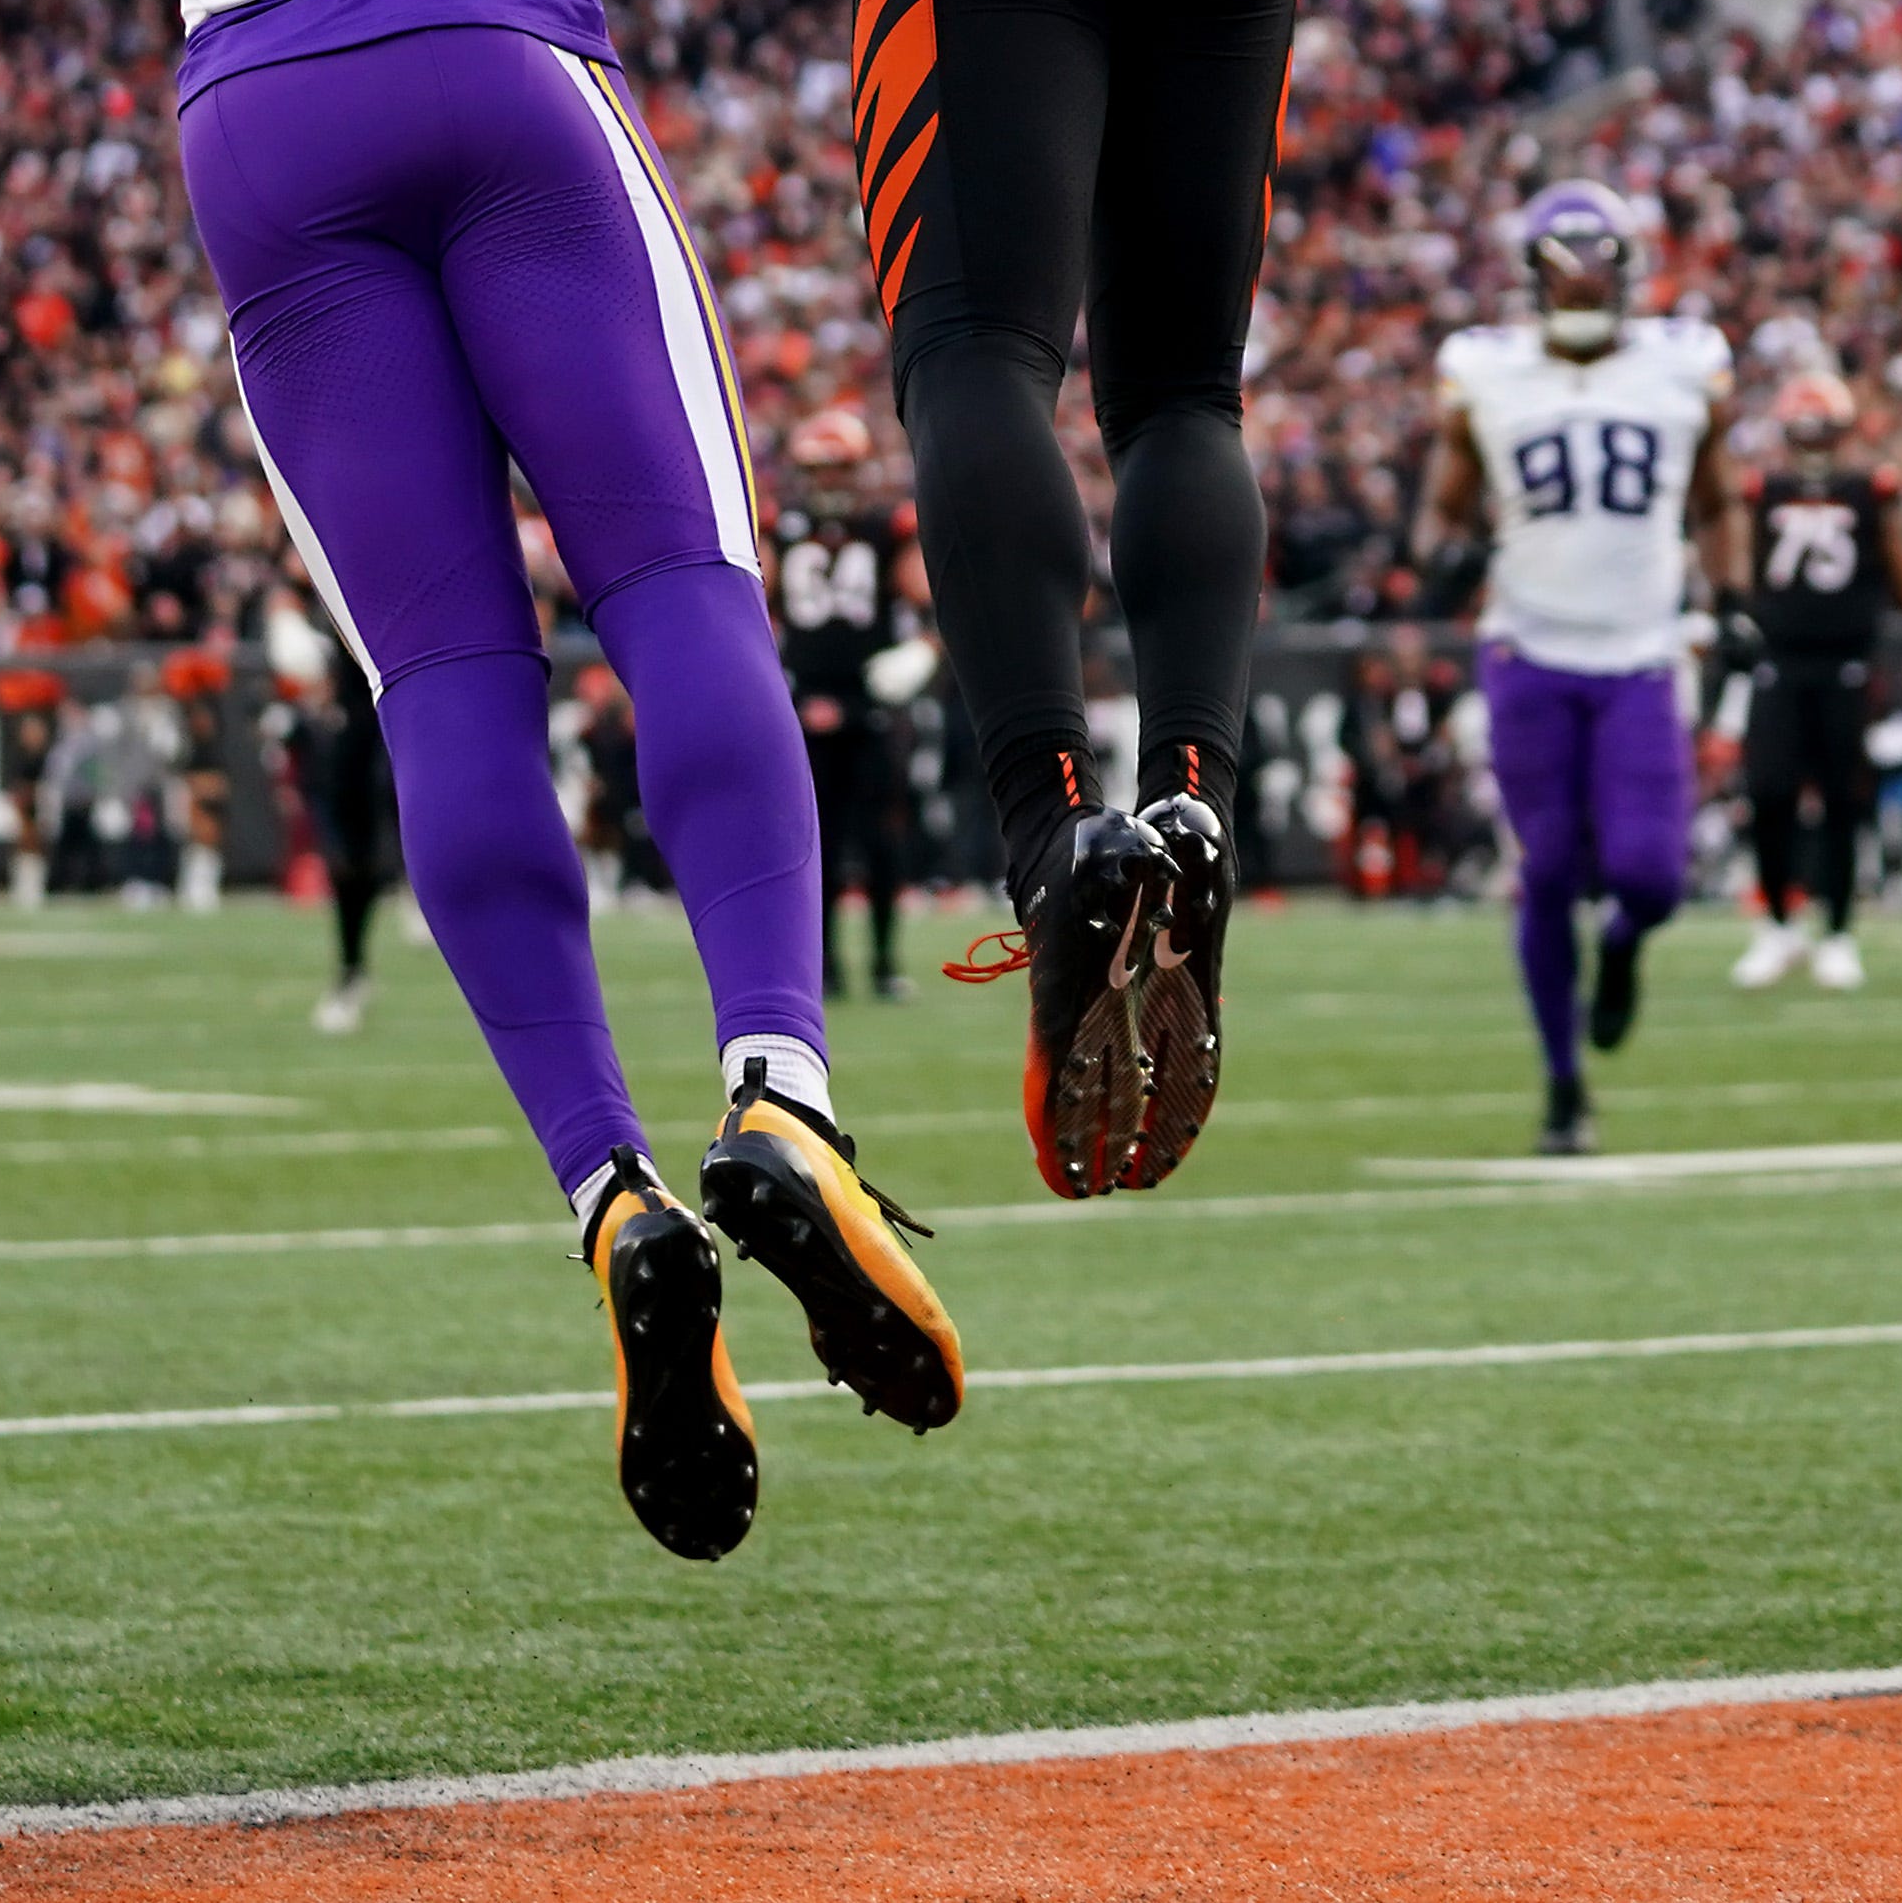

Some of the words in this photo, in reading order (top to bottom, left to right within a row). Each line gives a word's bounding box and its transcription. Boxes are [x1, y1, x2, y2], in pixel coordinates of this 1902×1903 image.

[1513, 420, 1665, 519] 98
[780, 538, 880, 630] 64
[1766, 504, 1859, 594] 75
